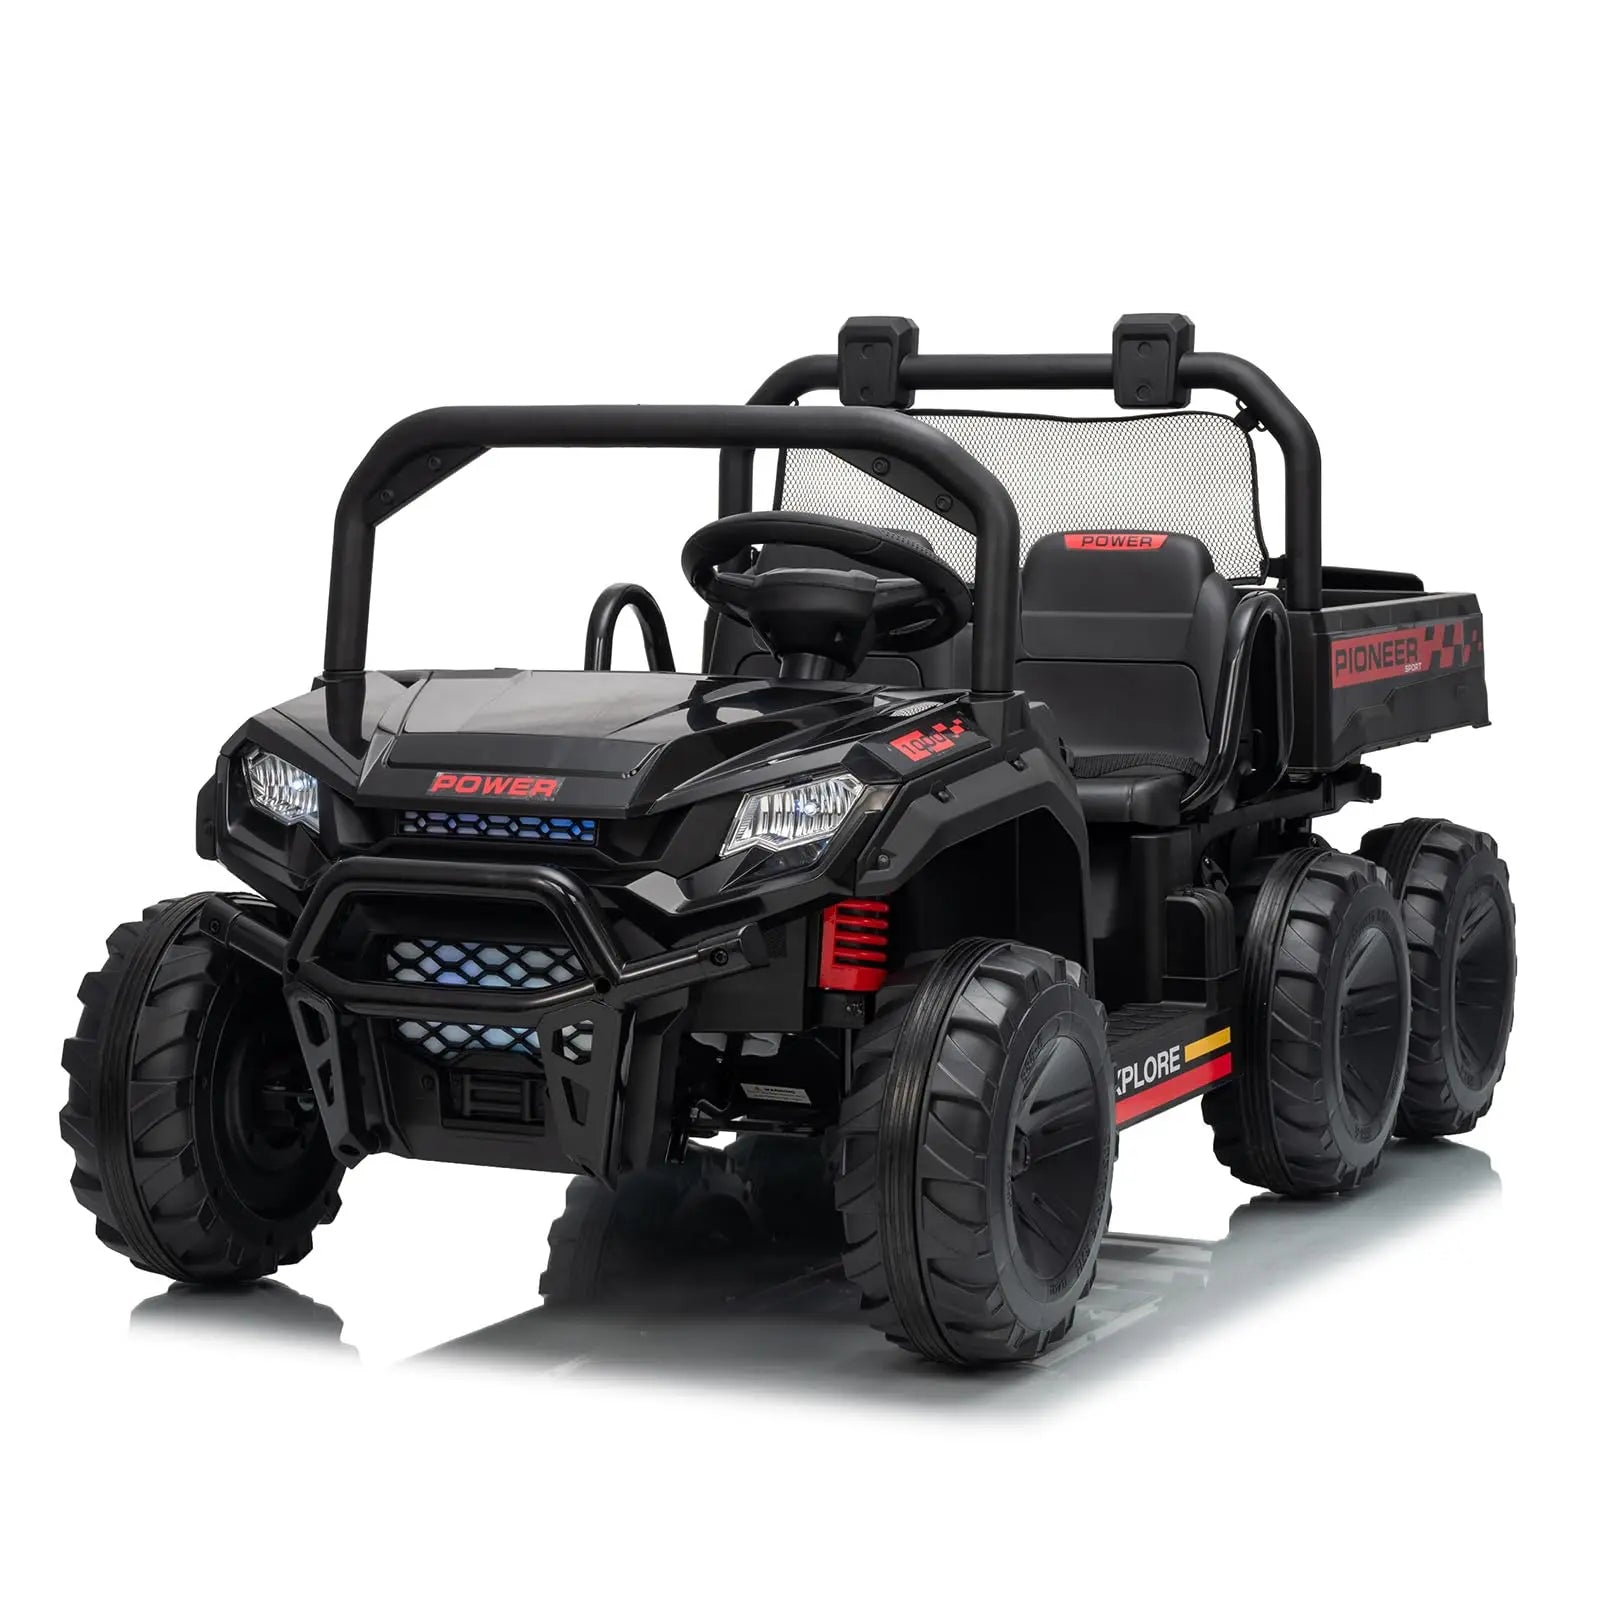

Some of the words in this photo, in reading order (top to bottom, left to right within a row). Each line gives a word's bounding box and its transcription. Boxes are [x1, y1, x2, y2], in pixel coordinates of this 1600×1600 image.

[1081, 535, 1153, 547] POWER
[1335, 637, 1418, 677] PIONEER
[1404, 662, 1422, 673] SPORT
[431, 774, 558, 797] POWER
